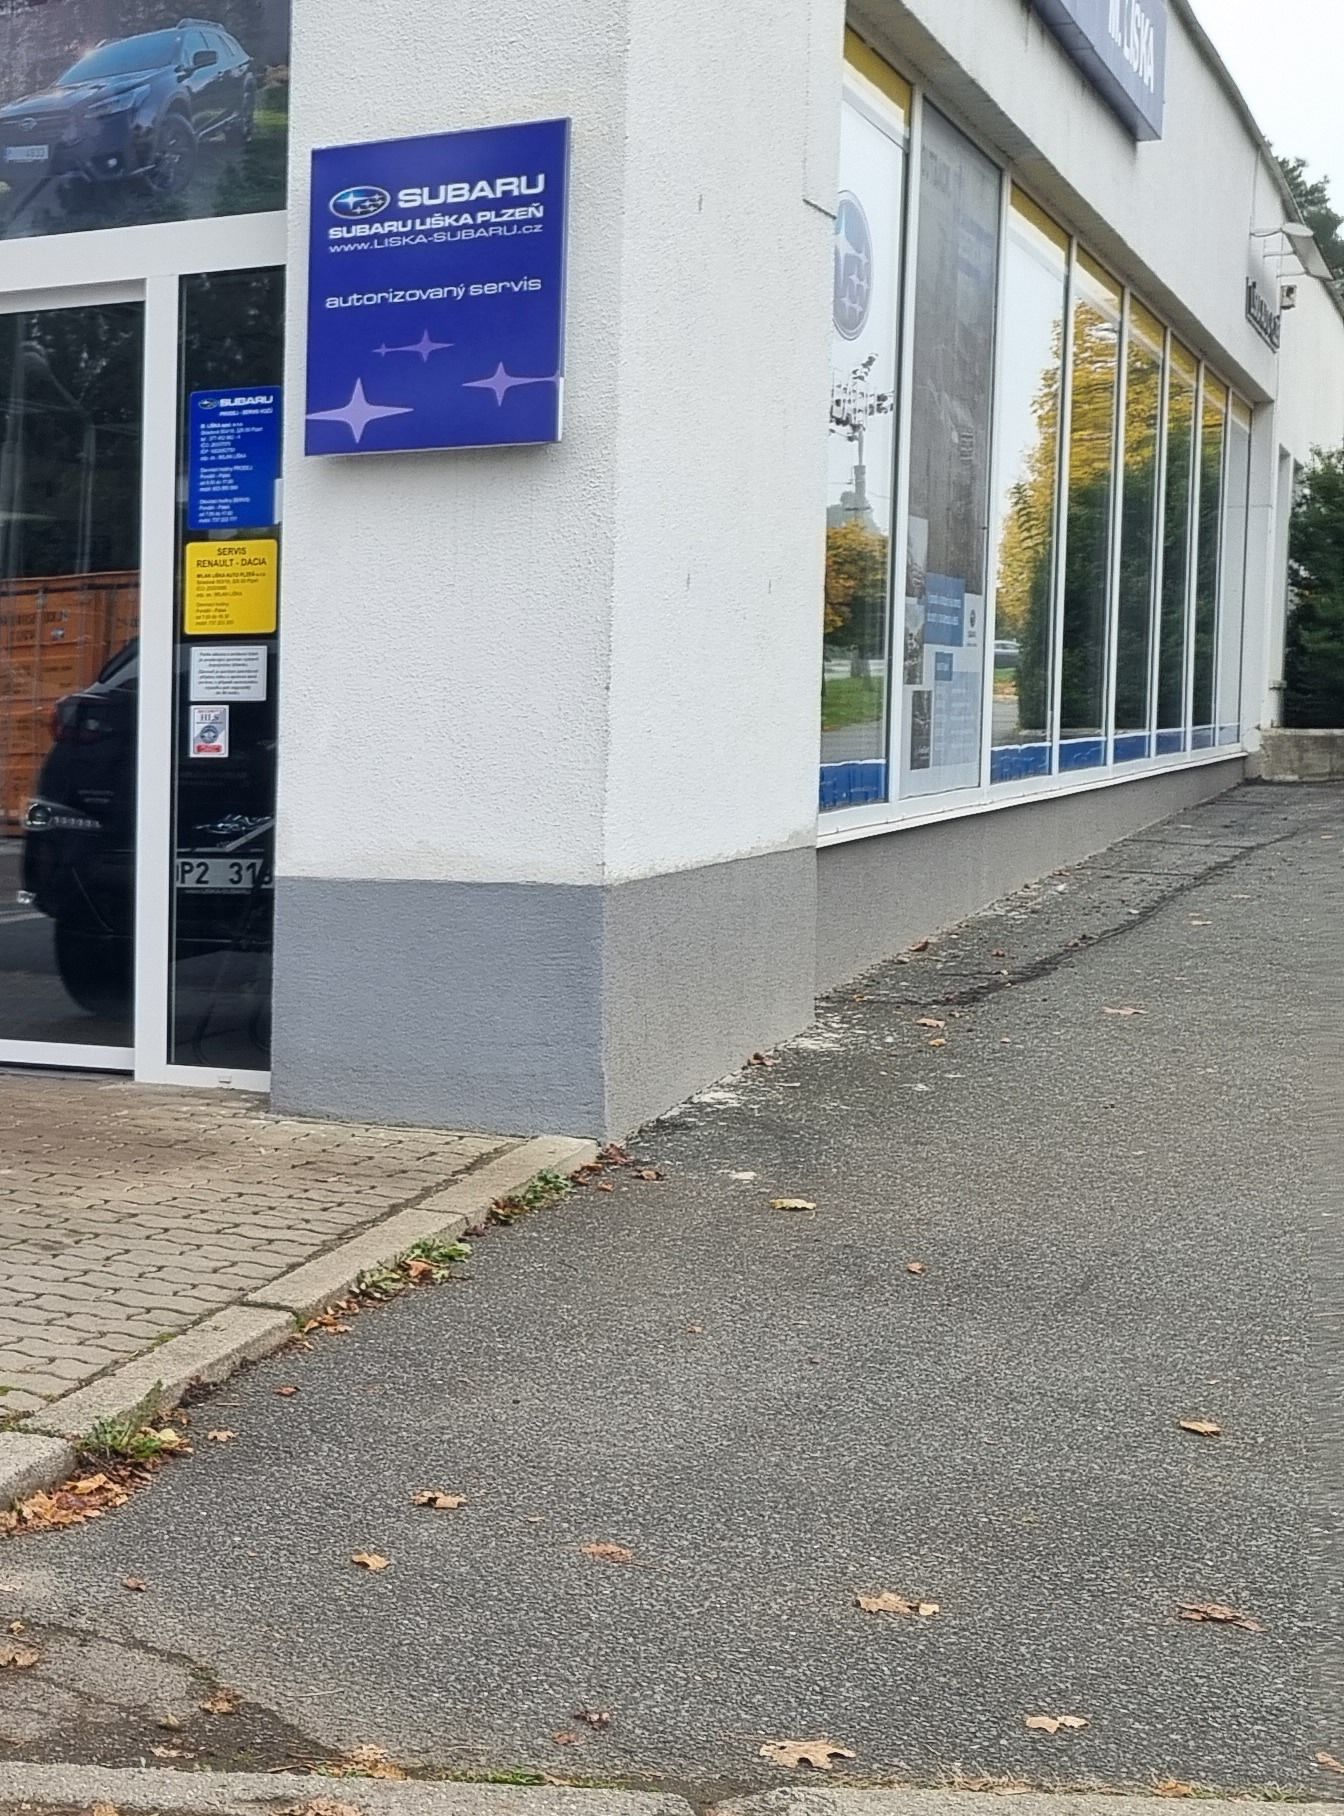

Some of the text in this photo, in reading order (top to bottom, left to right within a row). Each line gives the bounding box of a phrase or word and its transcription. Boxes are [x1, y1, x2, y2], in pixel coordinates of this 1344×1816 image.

[397, 173, 546, 209] SUBARU
[328, 203, 544, 240] SUBARU LIŠKA PLZEŇ
[328, 224, 544, 253] www.LISKA-SUBARU.cz
[325, 276, 542, 309] autorizovaný servis
[219, 395, 273, 408] SUBARU
[196, 559, 234, 568] RENAULT
[240, 557, 267, 566] DACIA
[217, 547, 247, 556] SERVIS
[176, 861, 209, 884] P2
